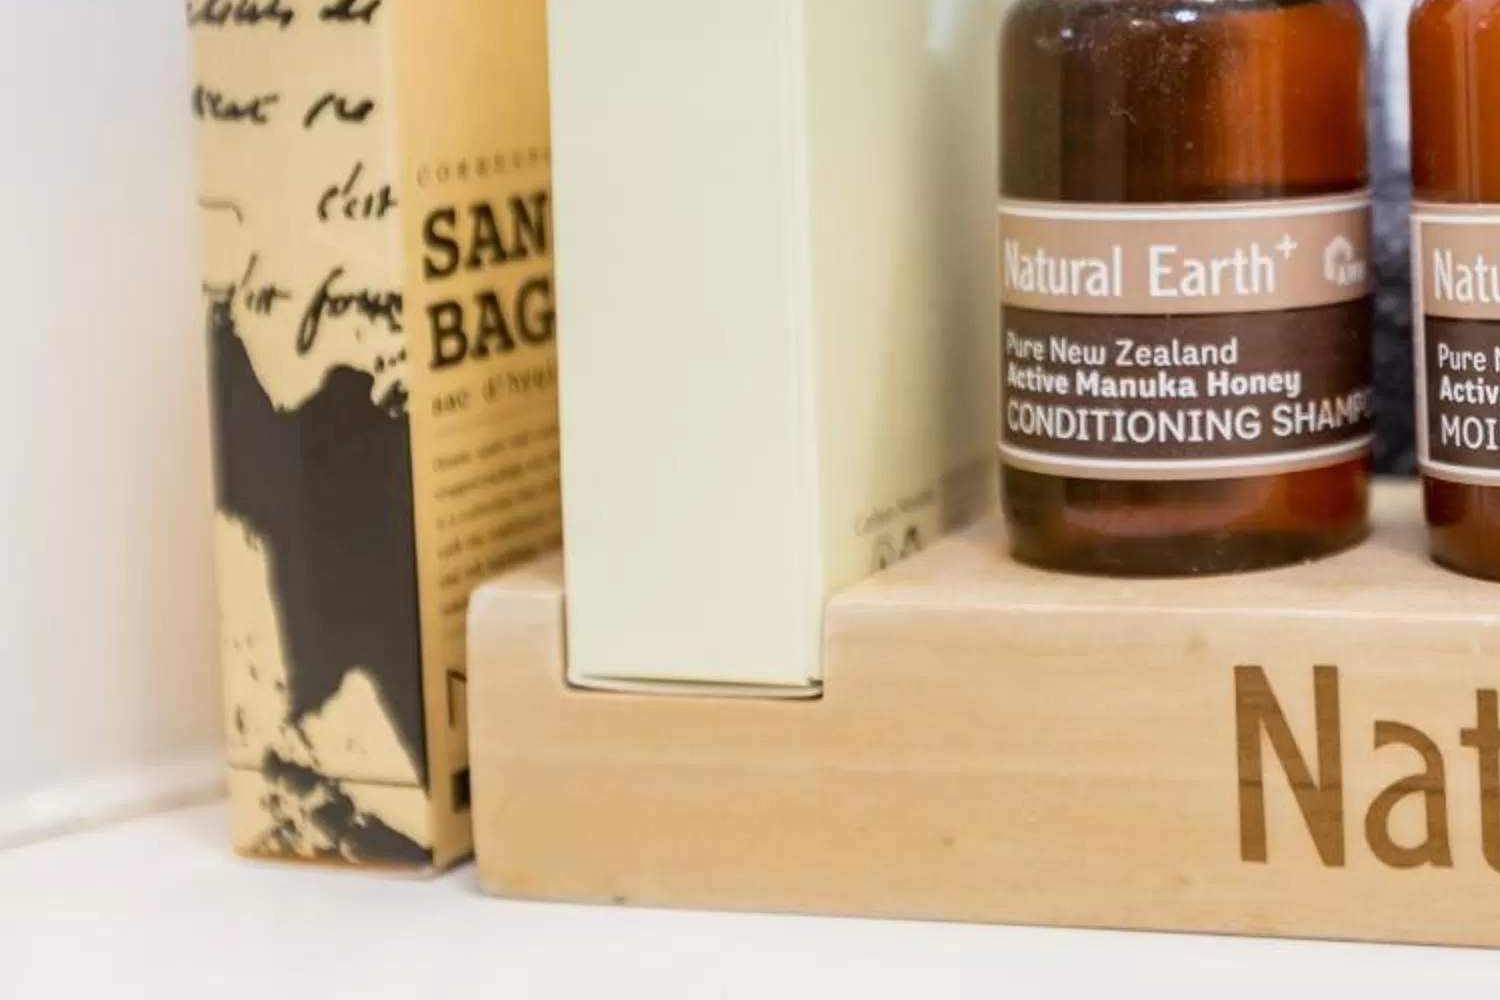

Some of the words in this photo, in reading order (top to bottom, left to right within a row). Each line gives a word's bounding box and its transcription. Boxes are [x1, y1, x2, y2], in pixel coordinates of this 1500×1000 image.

[1004, 238, 1122, 297] Natural
[425, 278, 555, 370] BAG
[1006, 332, 1044, 361] Pure
[1050, 336, 1106, 364] New
[1116, 338, 1238, 367] Zealand
[1438, 342, 1486, 371] Pure
[1007, 363, 1069, 395] Active
[1076, 371, 1198, 398] Manuka
[1207, 371, 1301, 398] Honey
[1007, 396, 1262, 443] CONDITIONING
